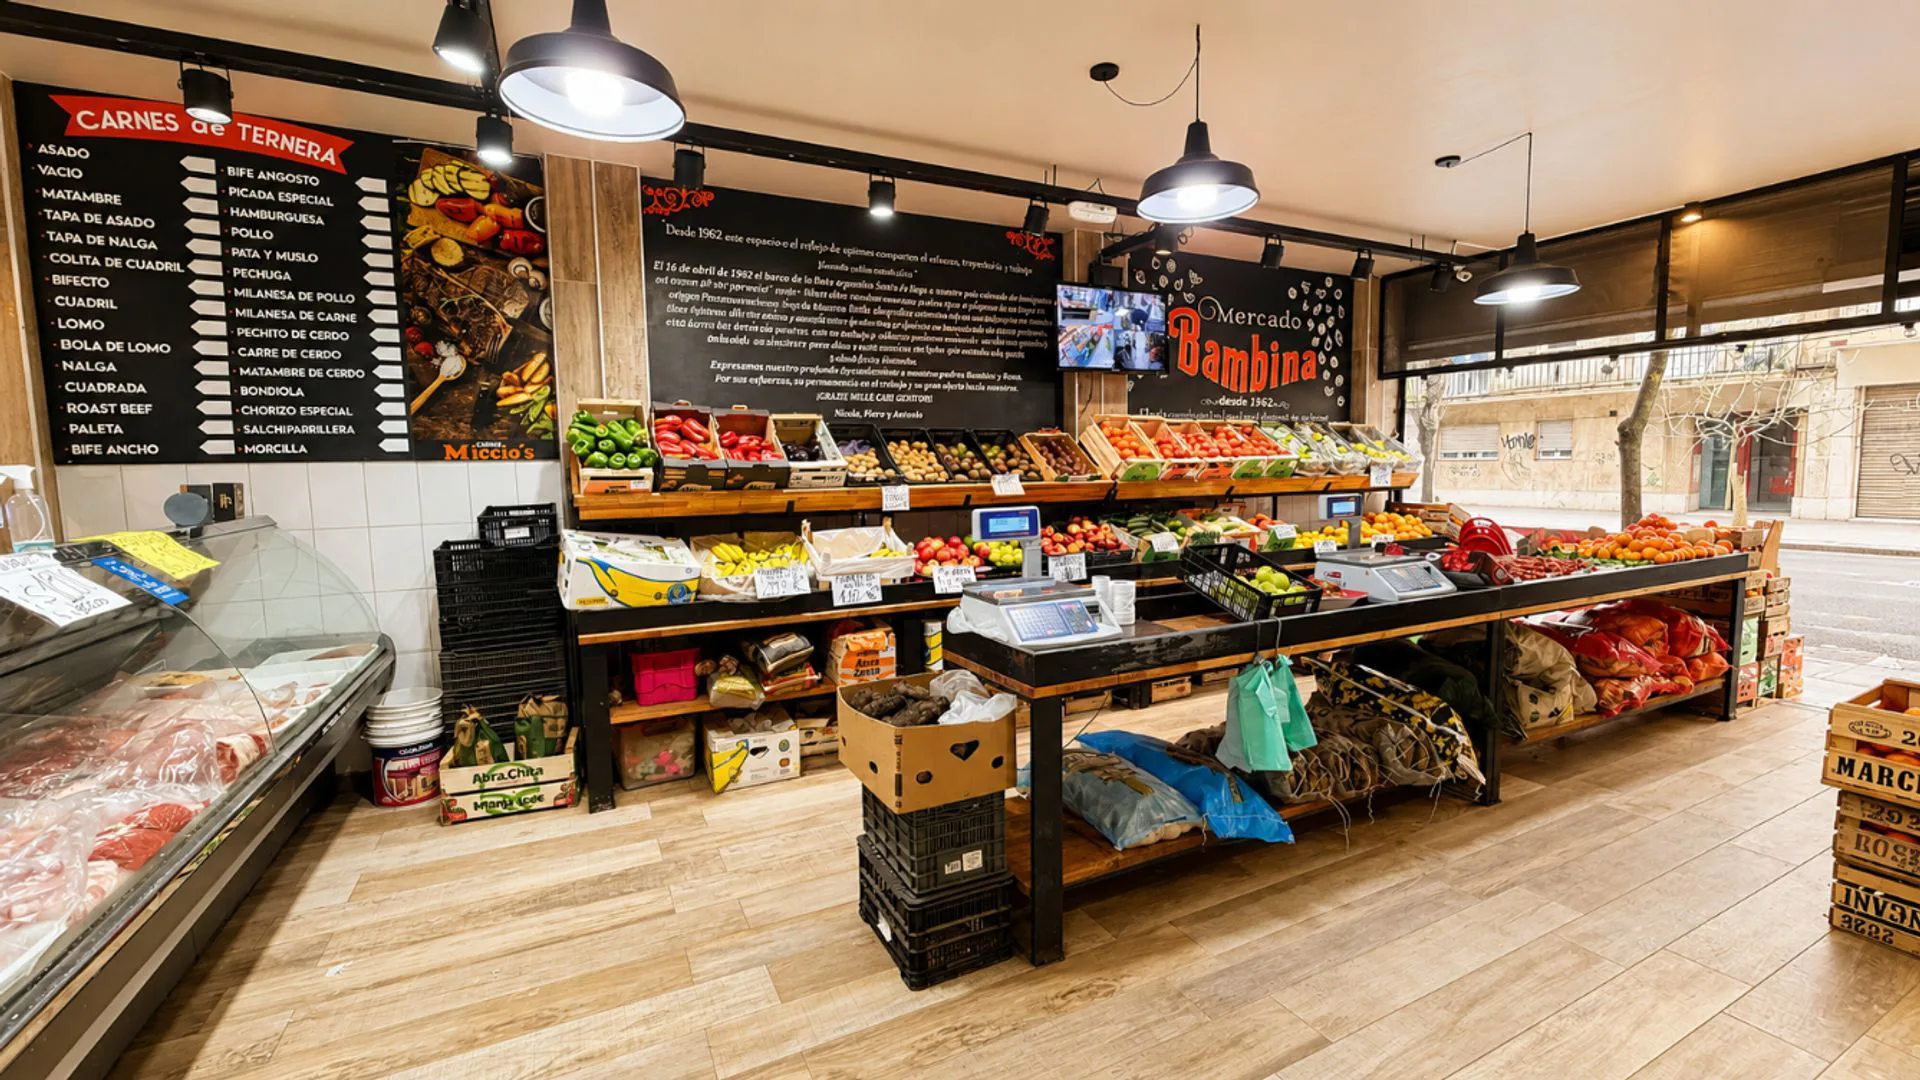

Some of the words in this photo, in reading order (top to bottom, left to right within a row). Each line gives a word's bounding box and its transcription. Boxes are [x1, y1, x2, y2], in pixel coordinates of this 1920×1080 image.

[76, 110, 179, 131] CARNES
[237, 122, 336, 165] TERNERA
[38, 144, 90, 159] ASADO
[37, 164, 83, 179] VACIO
[227, 166, 254, 178] BIFE
[257, 171, 320, 186] ANGOSTO
[42, 188, 122, 206] MATAMBRE
[229, 186, 275, 200] PICADA
[278, 192, 334, 207] ESPECIAL
[43, 209, 80, 222] TAPA
[84, 213, 102, 224] DE
[106, 215, 155, 228] ASADO
[230, 207, 325, 226] HAMBURGUESA
[46, 231, 83, 244] TAPA
[87, 234, 105, 246] DE
[109, 238, 158, 250] NALGA
[231, 227, 274, 240] POLLO
[698, 227, 723, 241] 1962
[231, 247, 260, 259] PATA
[263, 250, 272, 260] Y
[276, 252, 318, 263] MUSLO
[50, 253, 101, 266] COLITA
[105, 257, 122, 268] DE
[126, 259, 185, 272] CUADRIL
[233, 268, 292, 281] PECHUGA
[653, 260, 664, 271] El
[666, 262, 677, 272] 16
[678, 263, 691, 273] de
[692, 264, 716, 276] abril
[717, 266, 729, 277] de
[754, 269, 763, 280] el
[764, 270, 790, 283] barco
[52, 274, 109, 288] BIFECTO
[55, 295, 117, 309] CUADRIL
[234, 287, 295, 301] MILANESA
[298, 292, 313, 301] DE
[317, 293, 355, 304] POLLO
[235, 307, 297, 321] MILANESA
[300, 311, 314, 321] DE
[317, 312, 357, 323] CARNE
[1198, 296, 1302, 330] Mercado
[57, 318, 105, 330] LOMO
[236, 328, 288, 339] PECHITO
[291, 329, 306, 340] DE
[309, 330, 349, 341] CERDO
[60, 339, 101, 351] BOLA
[106, 341, 125, 352] DE
[128, 342, 171, 353] LOMO
[1168, 306, 1317, 393] Bambina
[238, 348, 279, 358] CARRE
[282, 349, 297, 358] DE
[300, 350, 341, 359] CERDO
[62, 361, 117, 372] NALGA
[240, 367, 306, 378] MATAMBRE
[308, 368, 324, 378] DE
[326, 369, 365, 378] CERDO
[765, 364, 799, 374] nuestro
[715, 374, 731, 384] Por
[733, 376, 747, 385] sus
[65, 382, 147, 393] CUADRADA
[240, 386, 305, 397] BONDIOLA
[1219, 395, 1247, 407] desde
[67, 403, 117, 414] ROAST
[121, 404, 152, 414] BEEF
[241, 405, 296, 416] CHORIZO
[300, 406, 353, 416] ESPECIAL
[69, 424, 124, 434] PALETA
[71, 444, 103, 455] BIFE
[107, 444, 159, 455] ANCHO
[244, 444, 308, 454] MORCILLA
[1836, 755, 1920, 796] MARC
